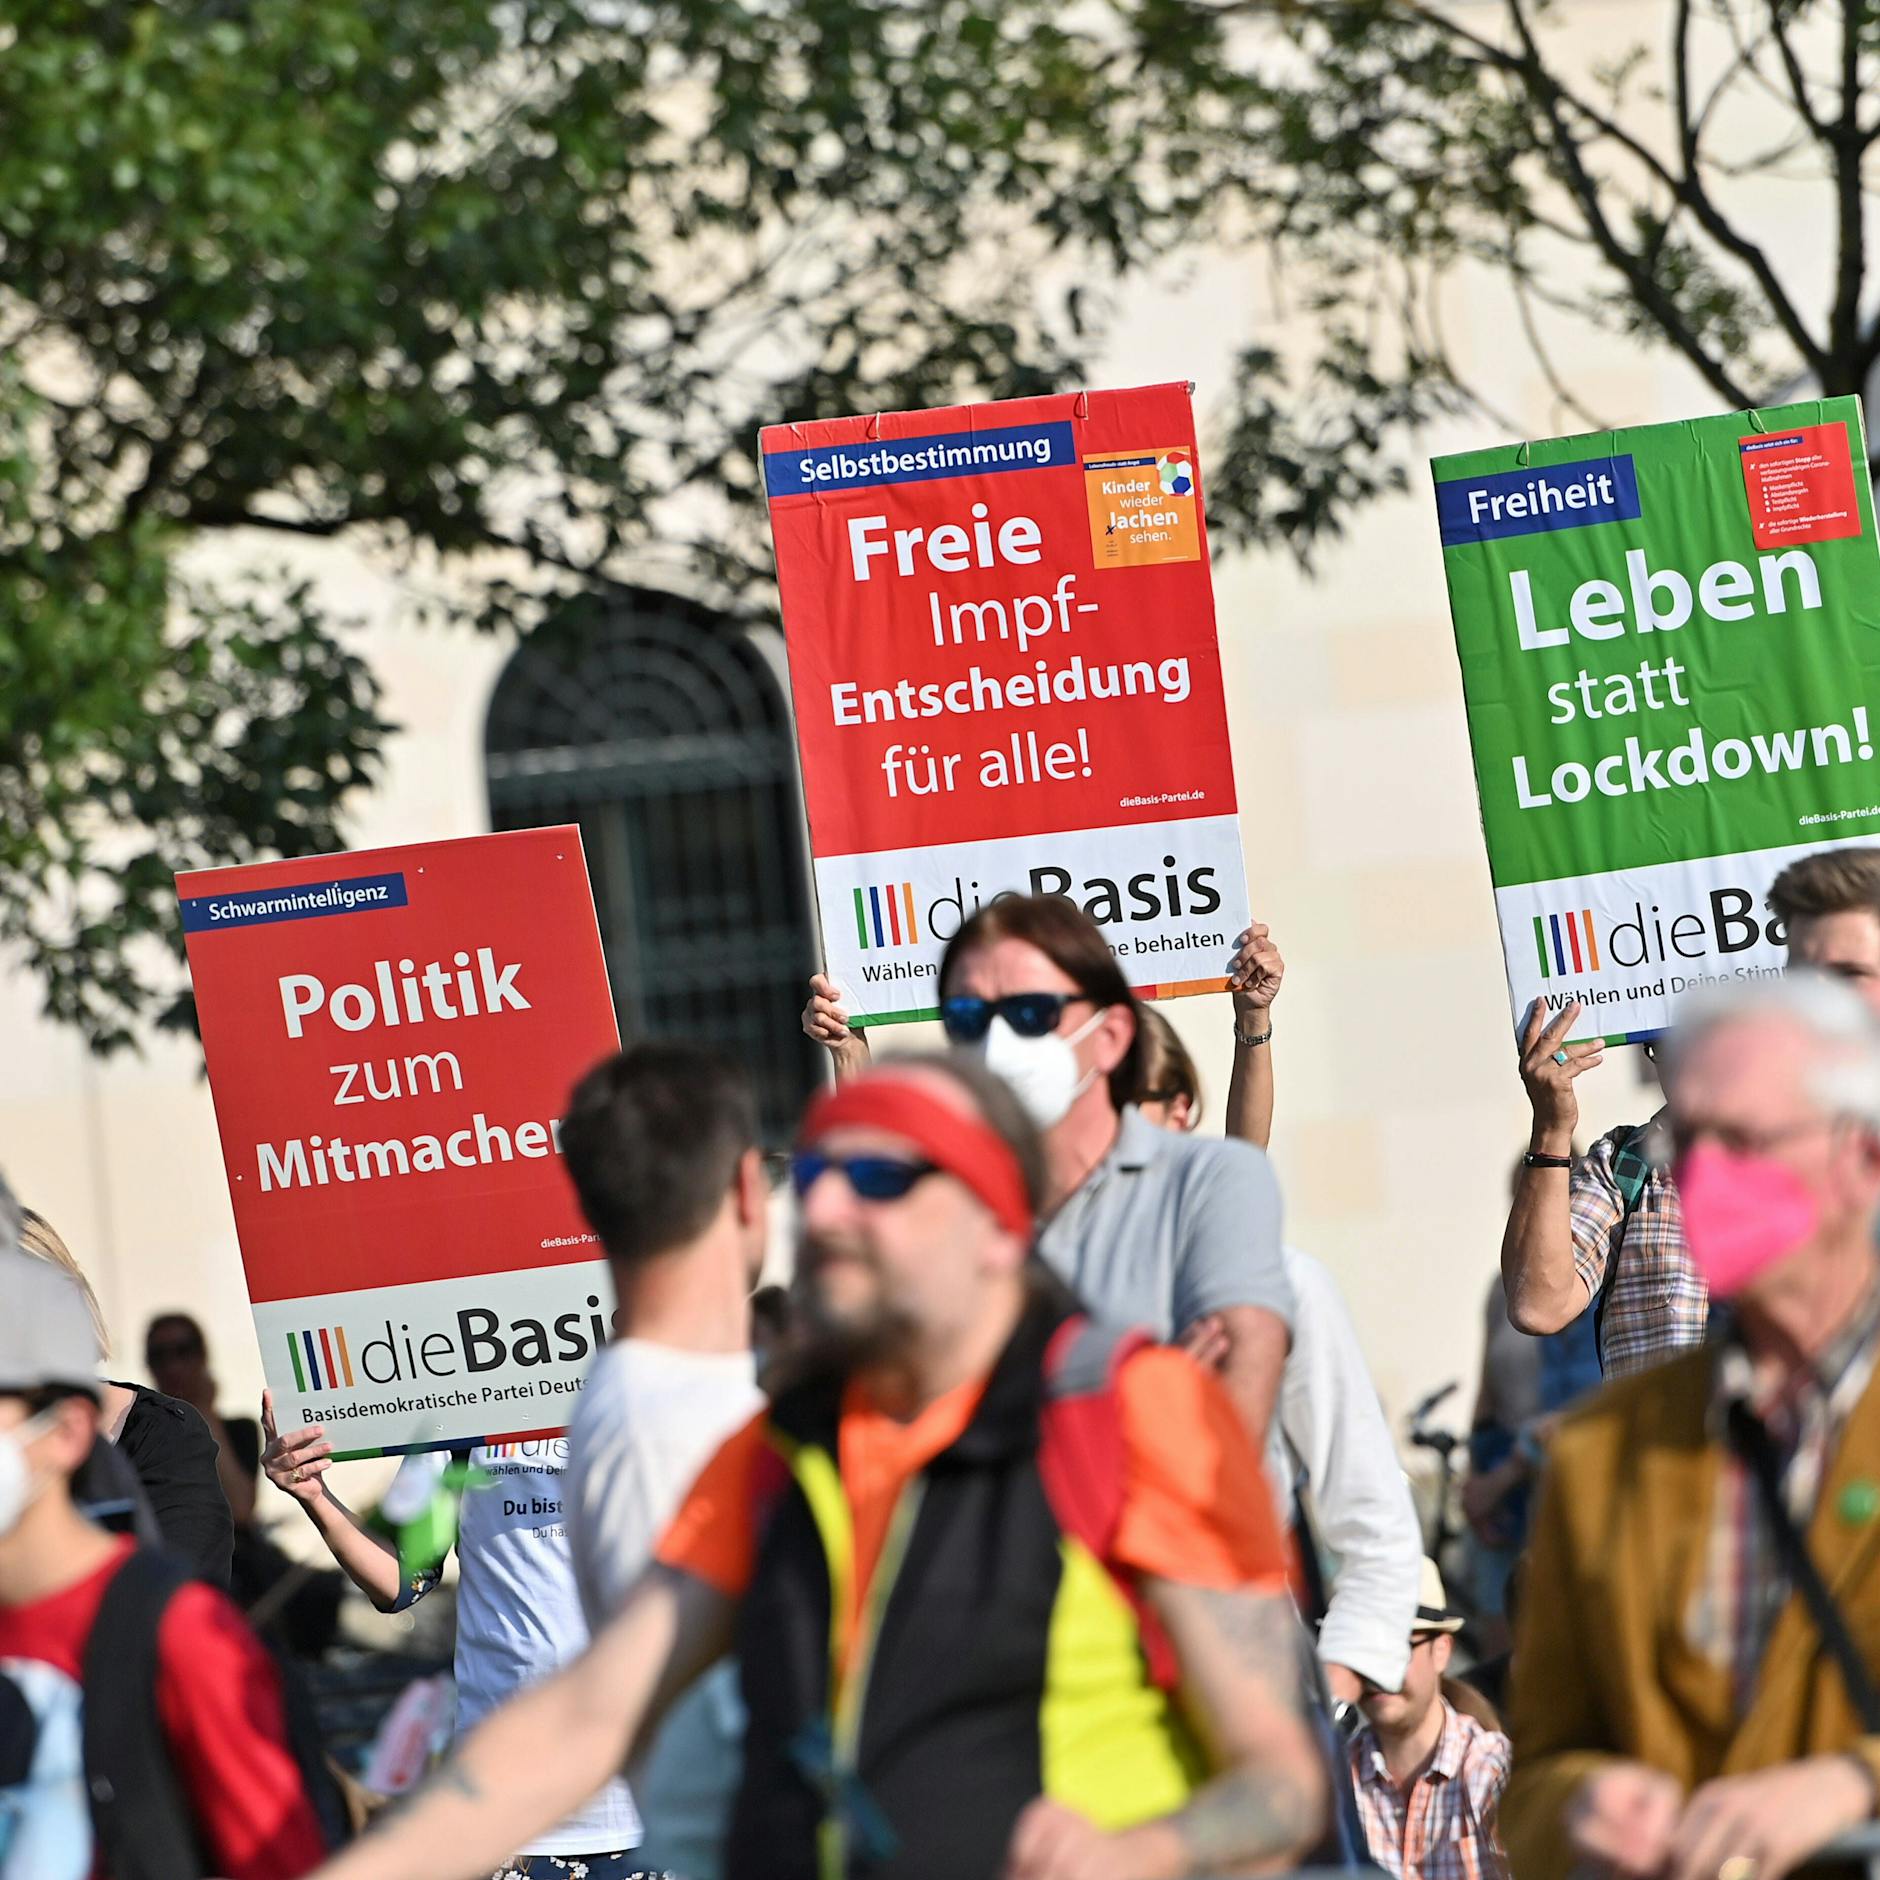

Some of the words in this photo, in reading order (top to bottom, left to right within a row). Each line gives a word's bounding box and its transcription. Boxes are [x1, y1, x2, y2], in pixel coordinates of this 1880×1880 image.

[800, 434, 1052, 484] Selbstbestimmung
[1102, 479, 1151, 495] Kinder
[1120, 494, 1164, 508] wieder
[1468, 472, 1615, 524] Freiheit
[847, 503, 1044, 582] Freie
[1130, 531, 1172, 544] sehen.
[928, 573, 1099, 653] Impf-
[1508, 548, 1823, 652] Leben
[830, 655, 1192, 727] Entscheidung
[1547, 656, 1690, 725] statt
[880, 743, 962, 798] für
[979, 727, 1093, 787] alle!
[1511, 705, 1874, 810] Lockdown!
[1120, 789, 1205, 808] dieBasis-Partei.de
[208, 884, 389, 921] Schwarmintelligenz
[861, 959, 938, 984] Wählen
[1135, 931, 1225, 956] behalten
[278, 946, 532, 1039] Politik
[1545, 988, 1620, 1011] Wählen
[1626, 978, 1665, 1000] und
[1670, 972, 1729, 994] Deine
[1734, 964, 1788, 984] Stim
[329, 1049, 464, 1106] zum
[302, 1389, 478, 1424] Basisdemokratische
[482, 1381, 534, 1403] Partei
[522, 1465, 544, 1474] und
[503, 1499, 528, 1516] Du
[531, 1497, 564, 1514] bist
[532, 1526, 548, 1539] Du
